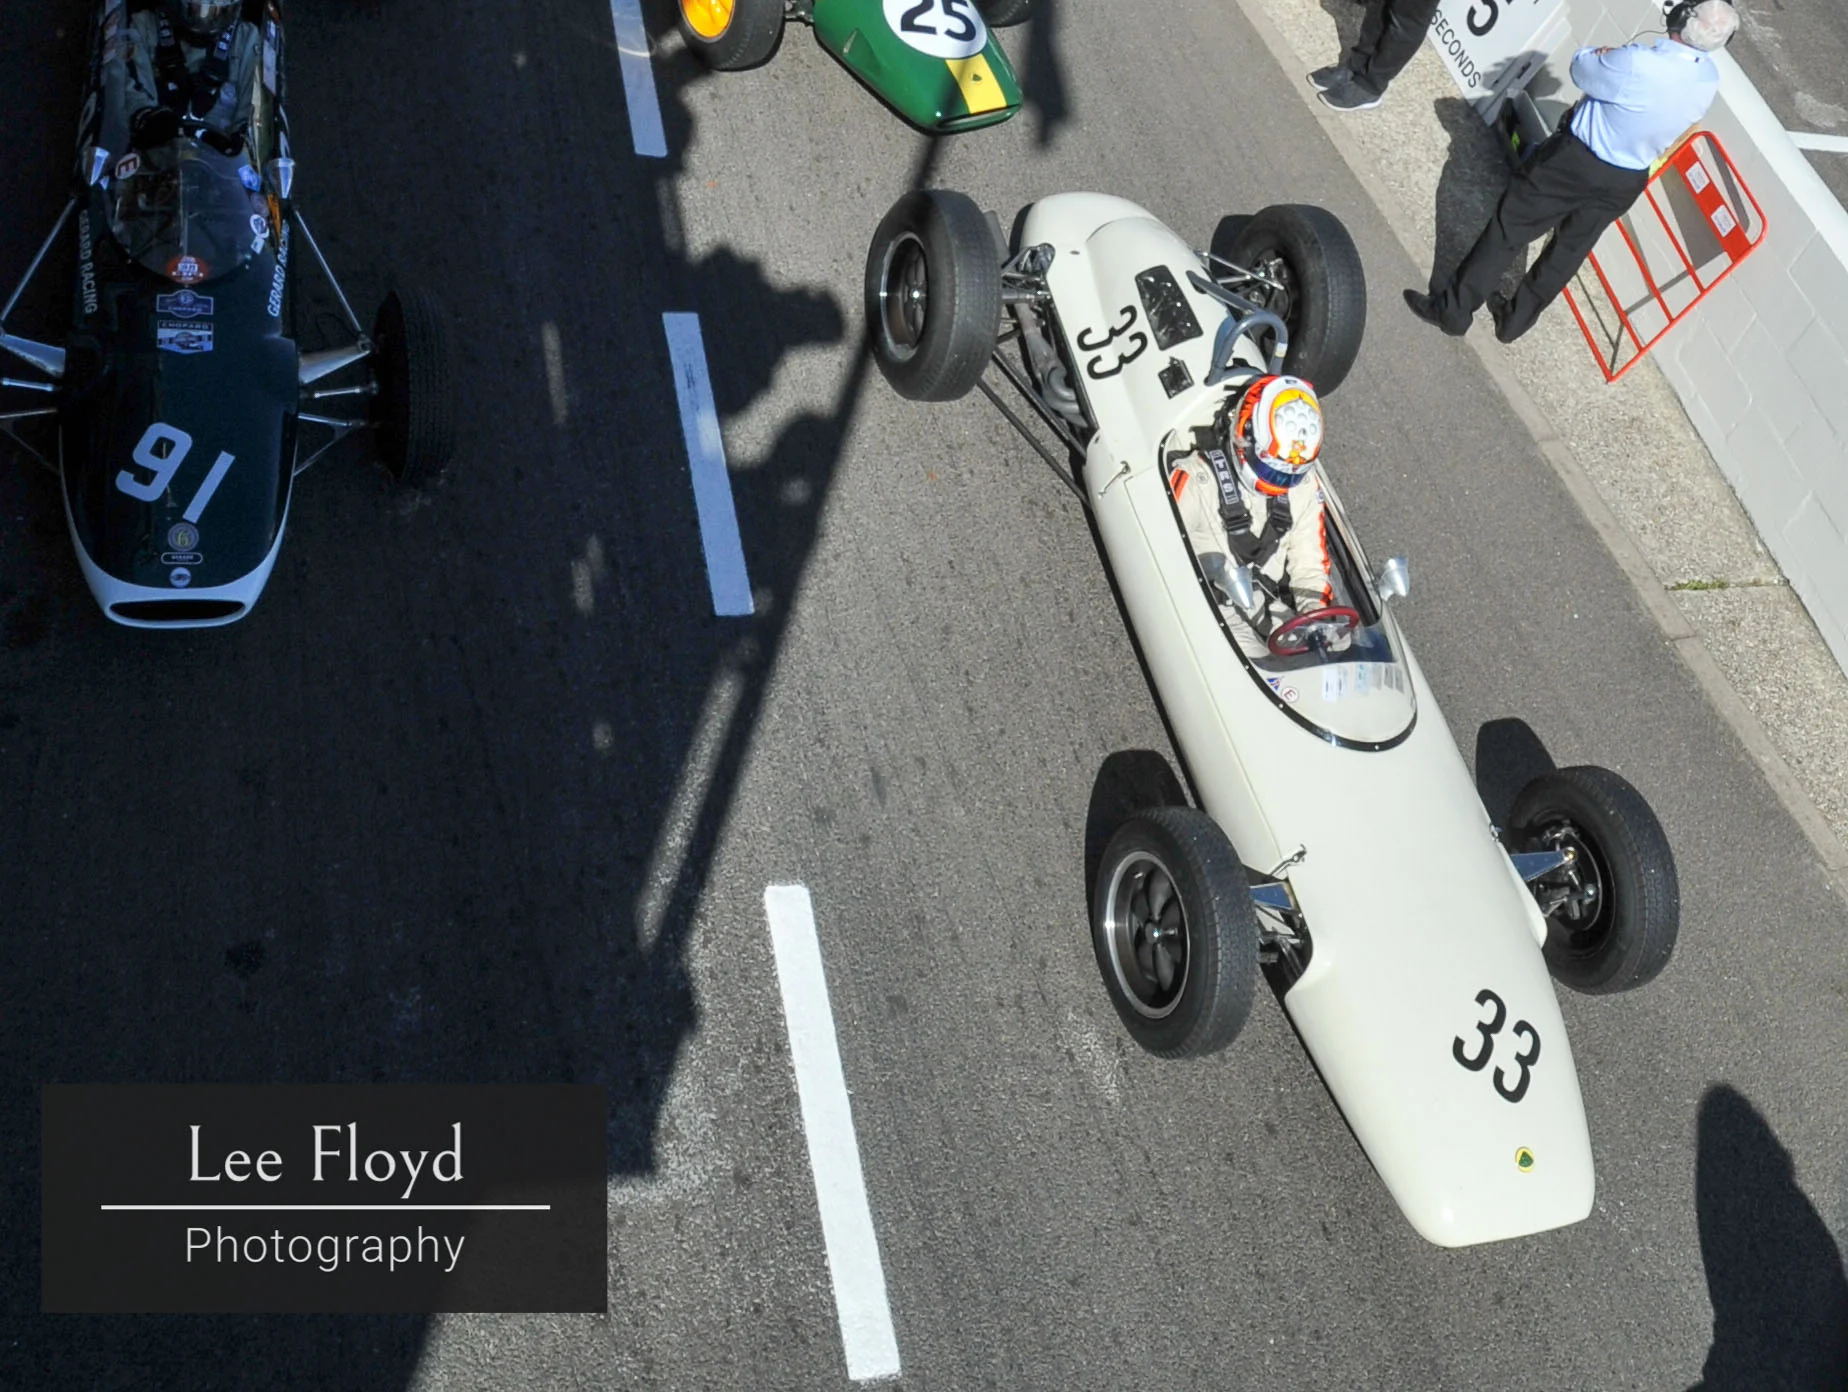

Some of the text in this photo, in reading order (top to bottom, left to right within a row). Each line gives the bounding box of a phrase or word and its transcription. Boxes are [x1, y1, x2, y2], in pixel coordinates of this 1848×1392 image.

[1430, 9, 1482, 88] SECONDS
[79, 261, 97, 313] RACING
[266, 263, 286, 317] GERARD
[1077, 304, 1148, 380] 33
[115, 422, 236, 524] 91
[1451, 989, 1542, 1103] 33
